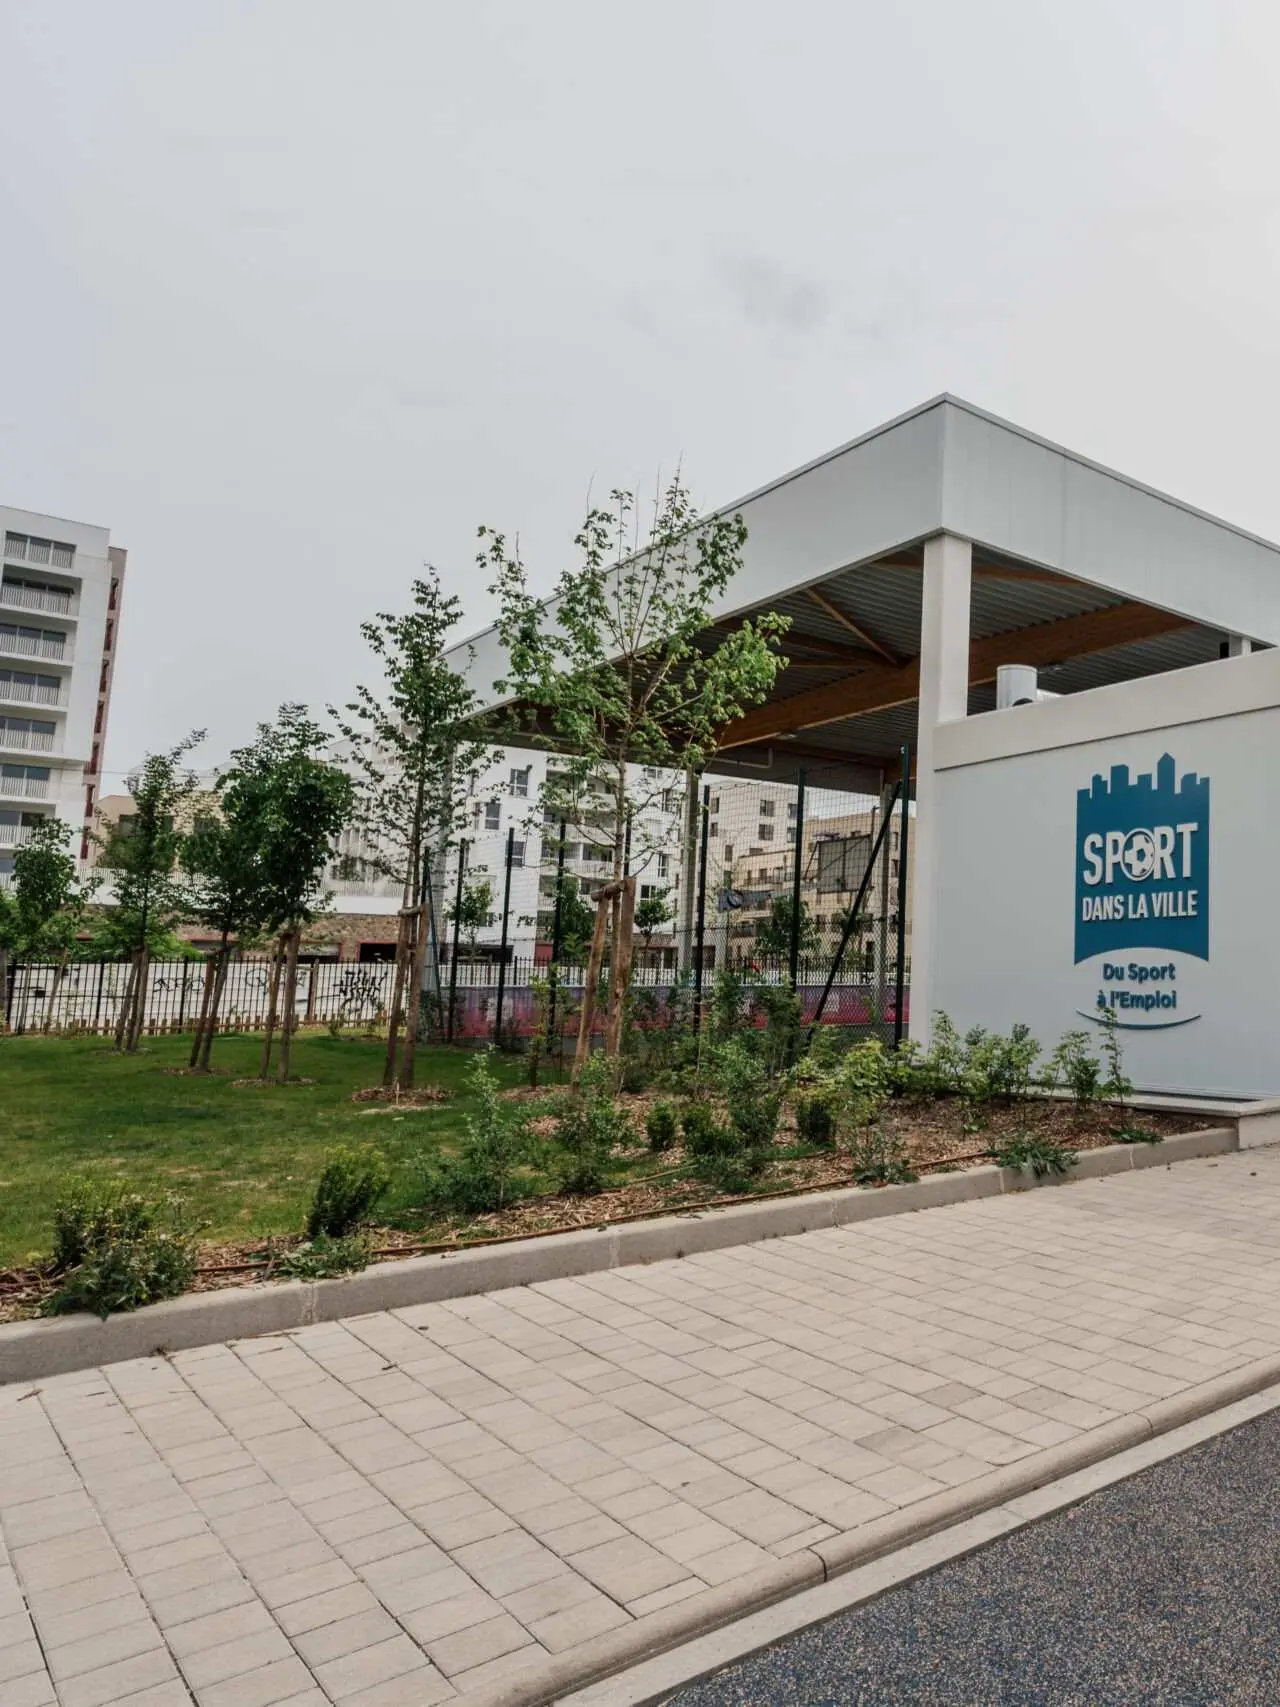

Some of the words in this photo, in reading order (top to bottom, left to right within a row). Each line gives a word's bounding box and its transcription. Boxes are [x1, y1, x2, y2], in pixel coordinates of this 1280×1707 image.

[1083, 822, 1199, 885] SPORT
[1082, 894, 1125, 921] DANS
[1128, 893, 1149, 919] LA
[1151, 889, 1199, 917] VILLE
[1103, 963, 1125, 981] Du
[1128, 962, 1176, 984] Sport
[1097, 988, 1106, 1008] à
[1110, 989, 1177, 1012] l'Emploi
